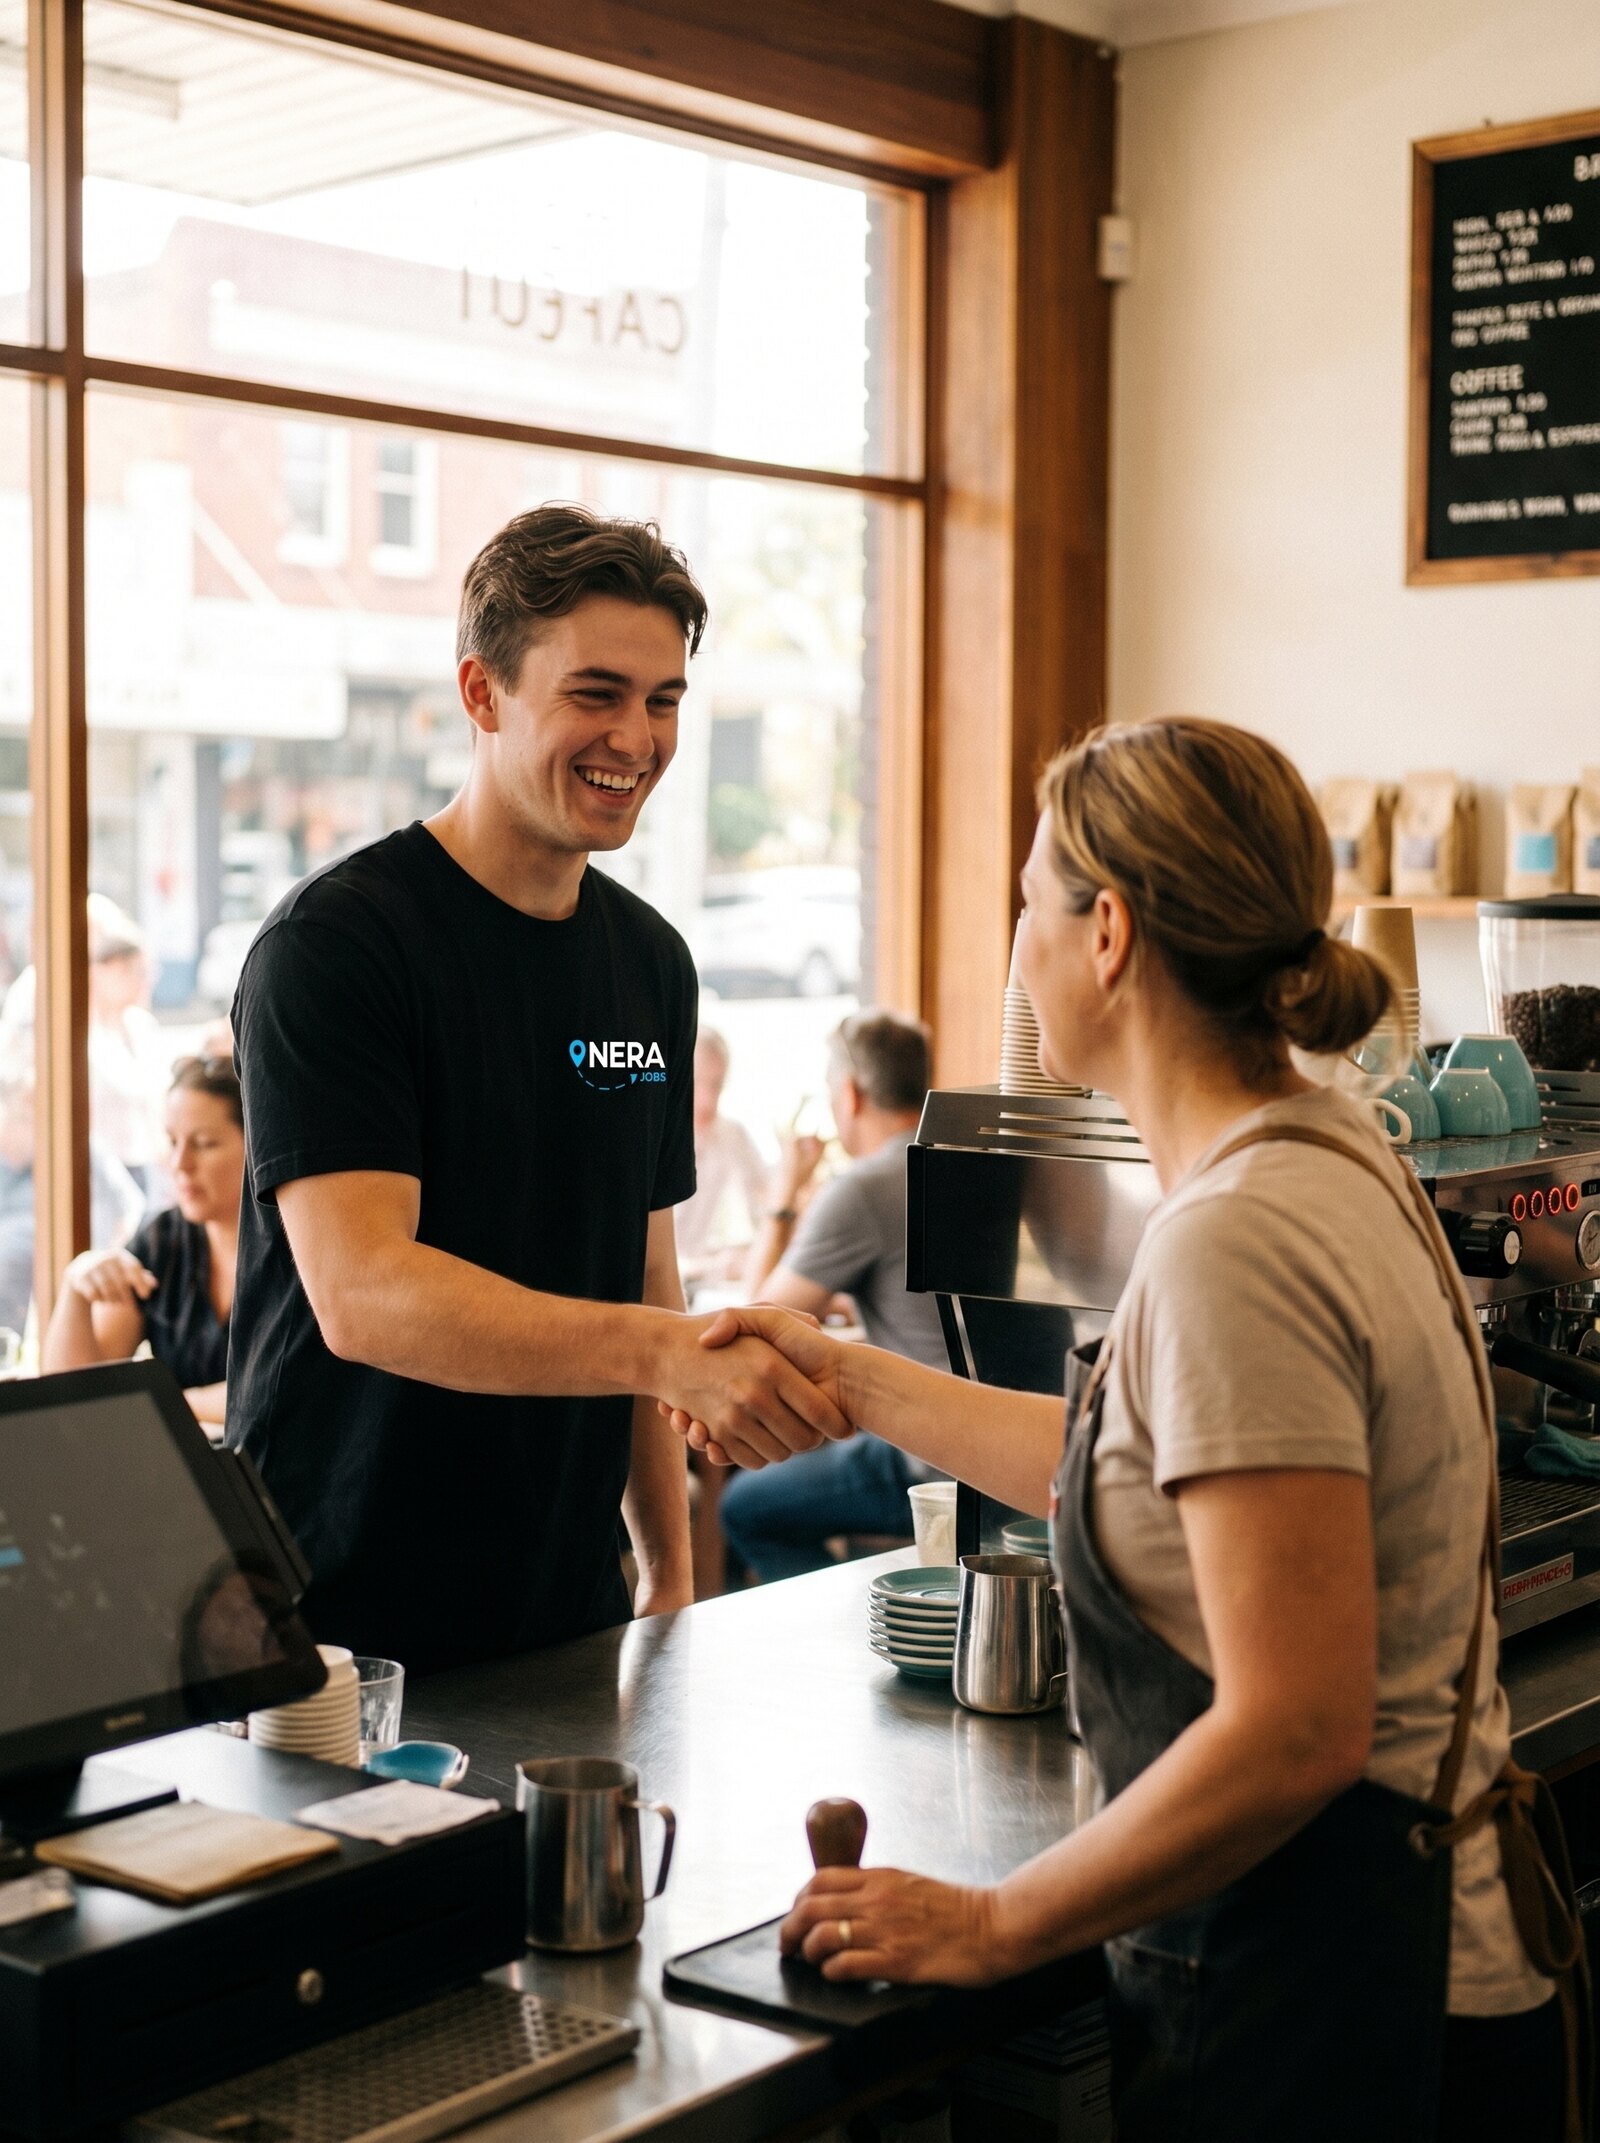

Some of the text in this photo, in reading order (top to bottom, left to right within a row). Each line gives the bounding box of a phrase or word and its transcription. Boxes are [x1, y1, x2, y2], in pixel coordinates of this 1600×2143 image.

[1450, 364, 1524, 396] COFFEE
[589, 1041, 666, 1068] NERA
[640, 1072, 667, 1082] JOBS
